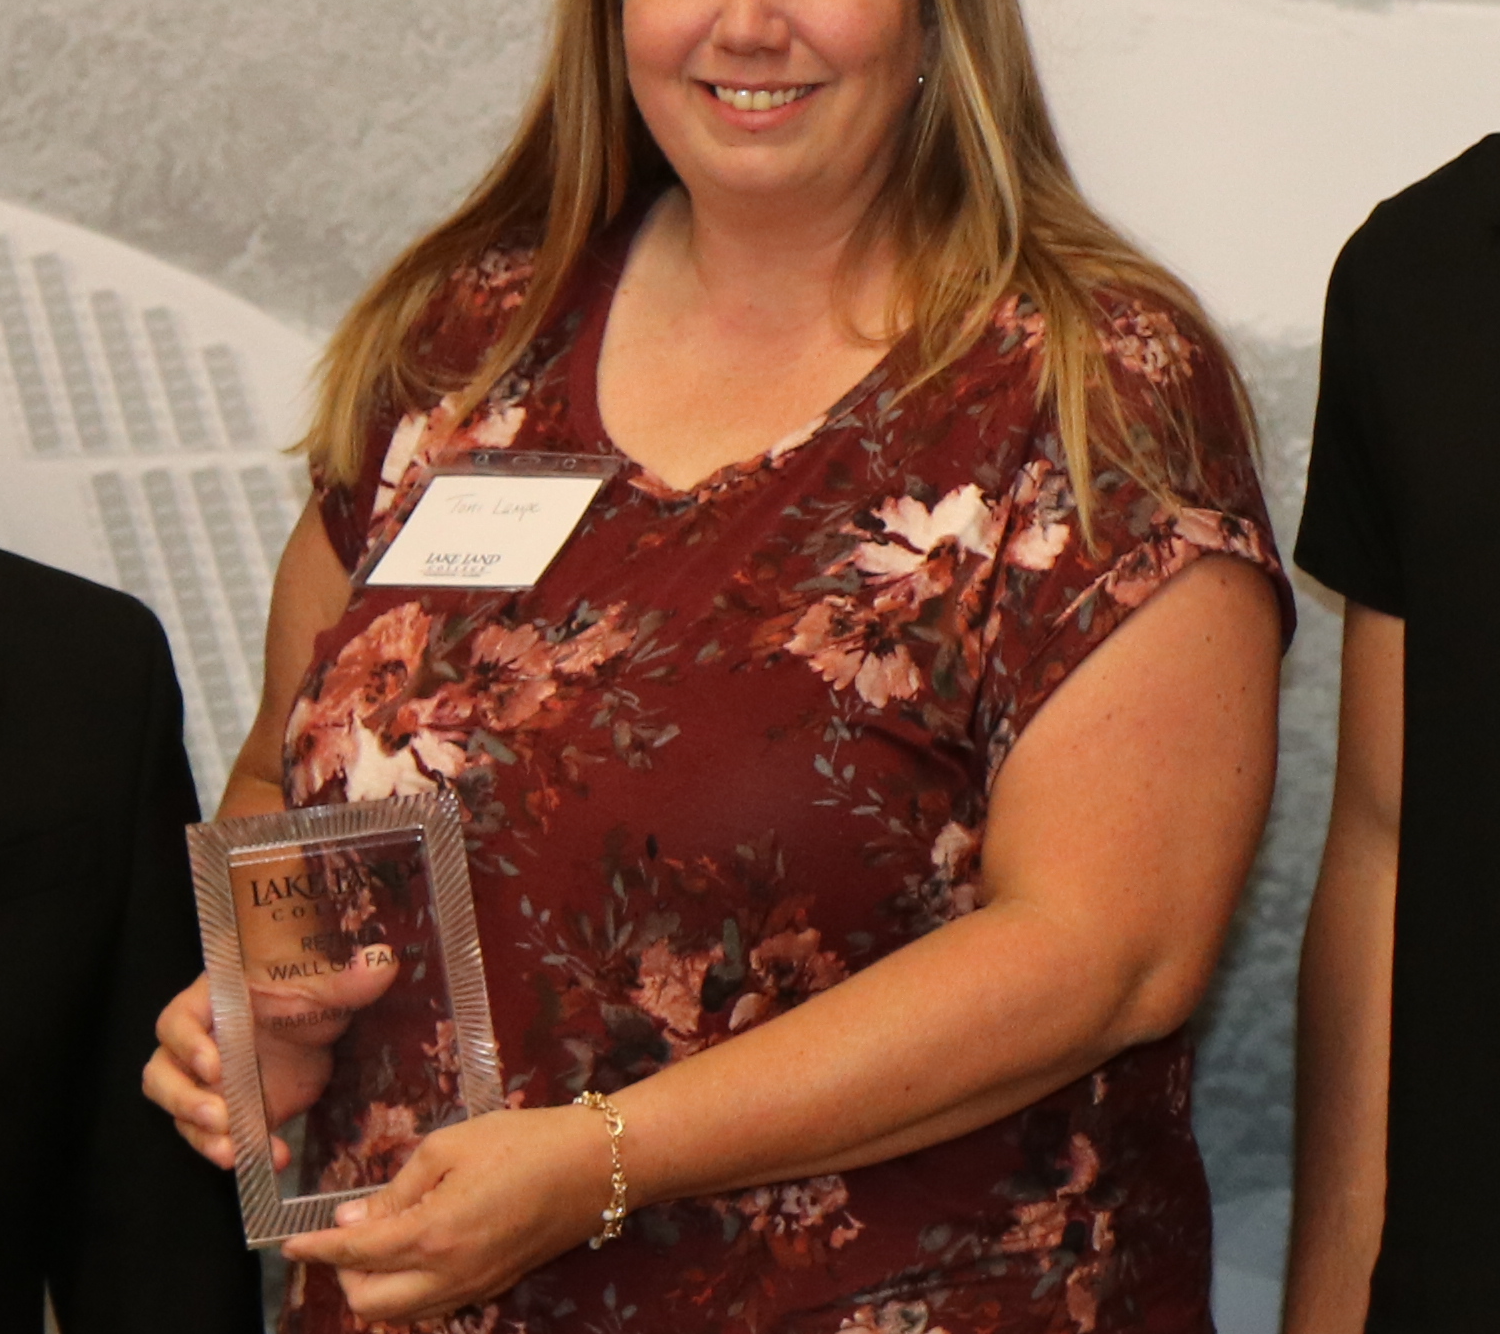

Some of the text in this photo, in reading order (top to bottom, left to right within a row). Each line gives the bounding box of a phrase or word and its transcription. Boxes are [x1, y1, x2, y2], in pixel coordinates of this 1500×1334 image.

[425, 552, 502, 566] LAKE LAND
[250, 871, 326, 908] LAKE
[267, 960, 324, 981] WALL
[329, 956, 356, 973] OF
